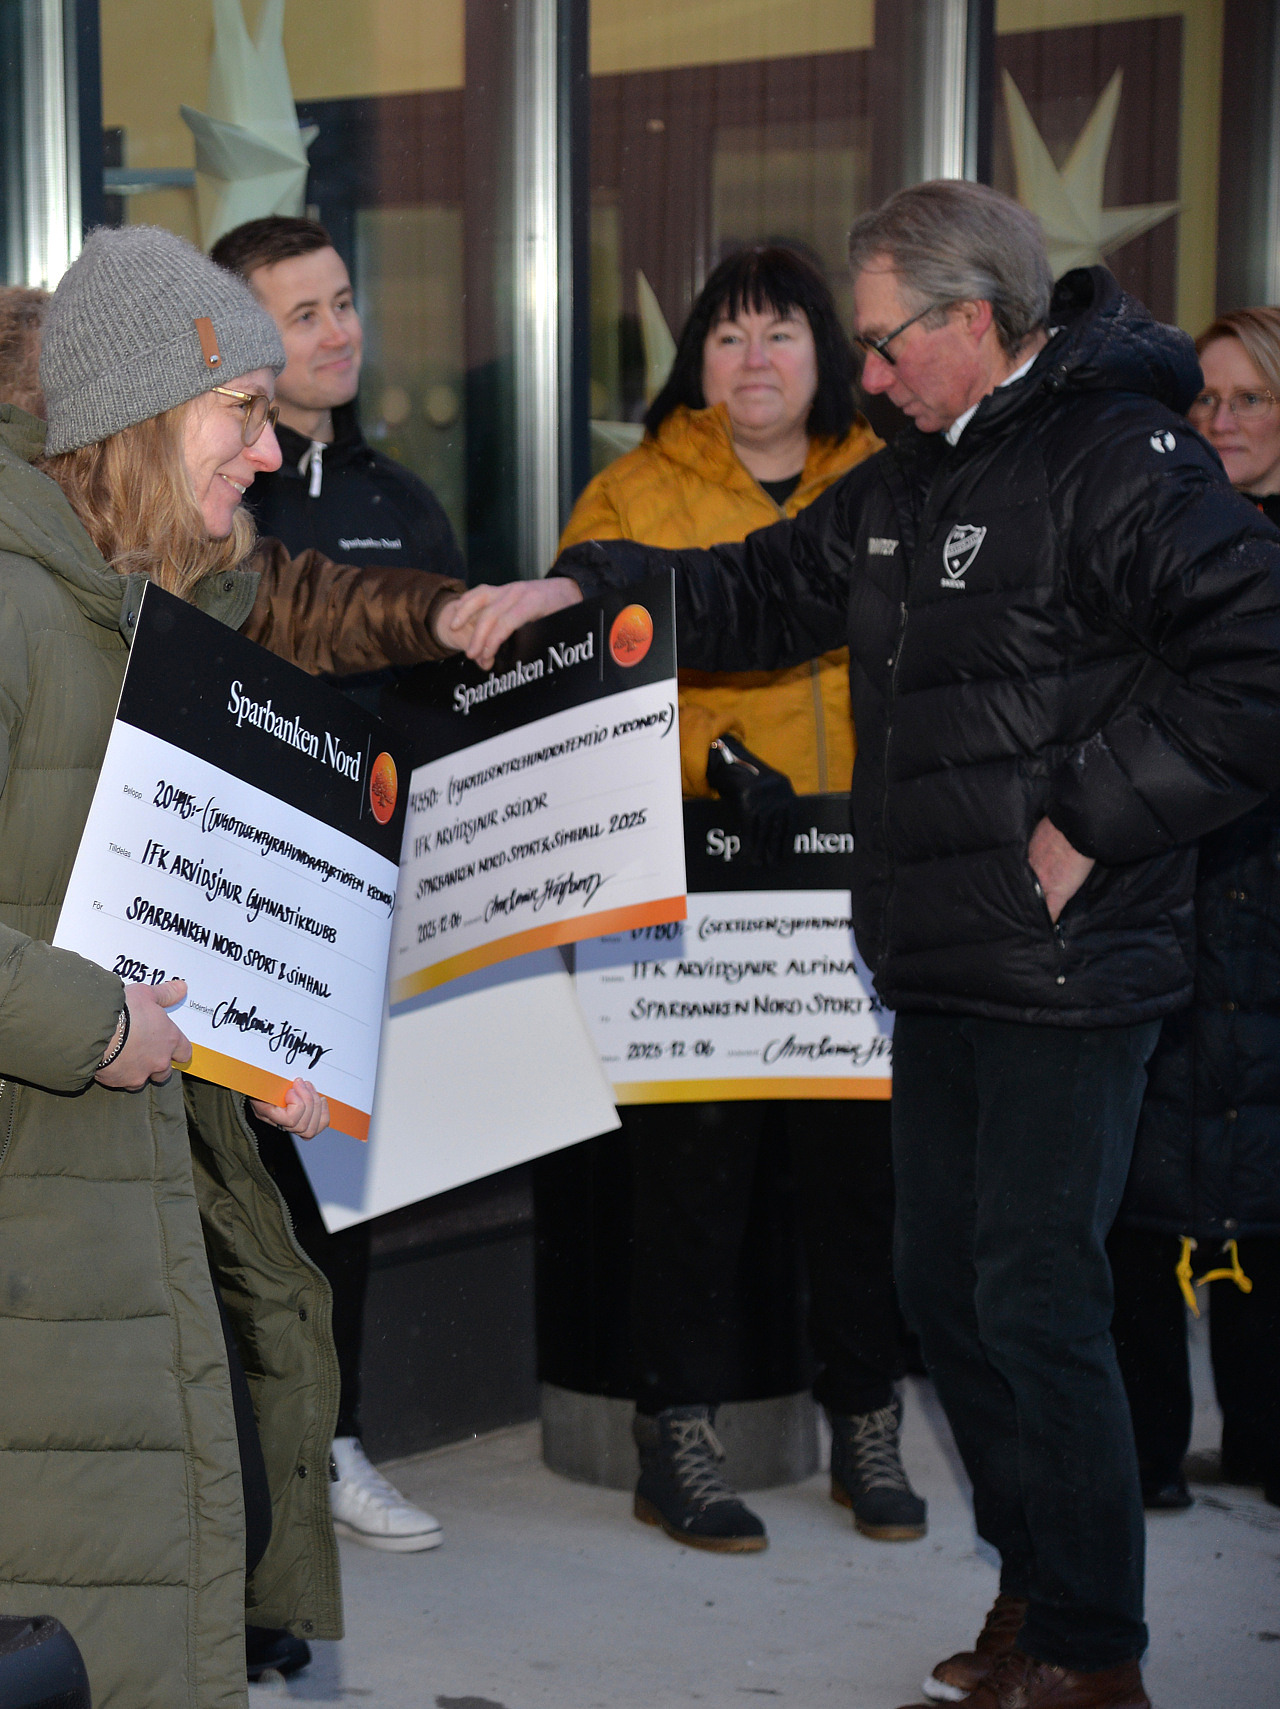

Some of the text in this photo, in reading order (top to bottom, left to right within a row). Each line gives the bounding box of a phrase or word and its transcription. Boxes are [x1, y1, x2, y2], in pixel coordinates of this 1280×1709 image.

[452, 632, 595, 715] Sparbanken Nord
[227, 680, 362, 782] Sparbanken Nord
[609, 808, 648, 835] 2025
[141, 839, 170, 870] IFK
[415, 834, 431, 858] IFK
[706, 826, 855, 861] Spnken
[92, 900, 104, 912] För
[126, 896, 211, 948] SPARBANKEN
[212, 932, 242, 962] NORD
[633, 959, 666, 979] IFK
